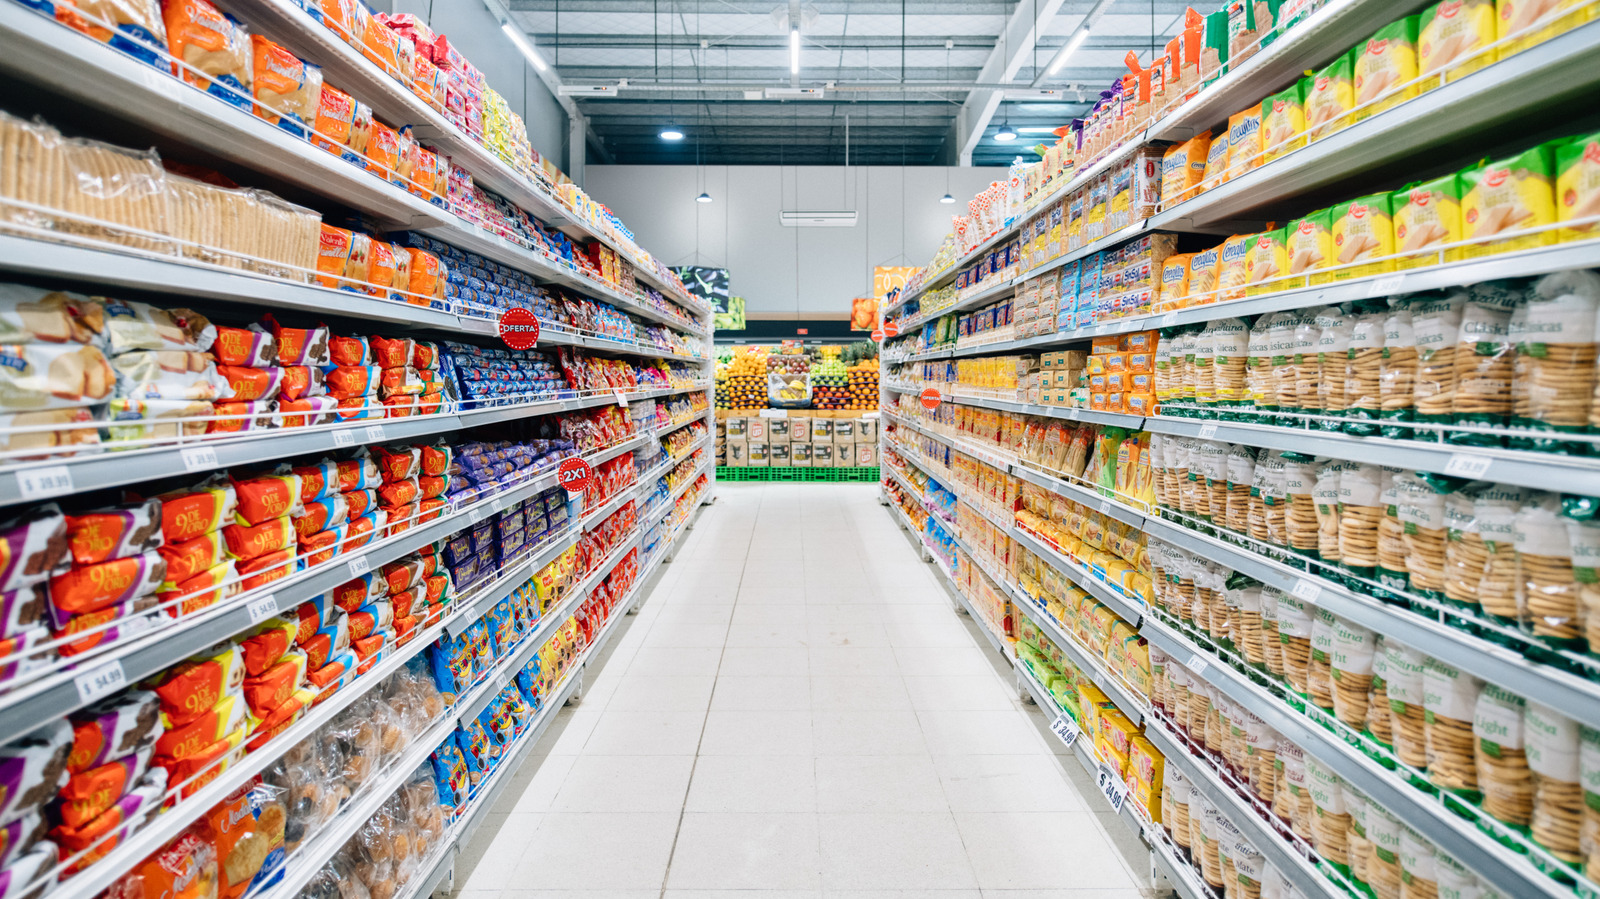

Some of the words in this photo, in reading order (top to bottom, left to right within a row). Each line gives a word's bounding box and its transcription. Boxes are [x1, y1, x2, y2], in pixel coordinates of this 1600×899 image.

[1122, 268, 1140, 282] SinSal
[1121, 294, 1139, 307] SinSal
[503, 324, 536, 332] OFERTA
[347, 374, 354, 391] 9
[354, 382, 365, 390] ORO
[563, 467, 586, 482] 2X1
[261, 495, 271, 515] 9
[270, 492, 280, 501] DE
[270, 501, 287, 513] ORO
[175, 514, 188, 535] 9
[187, 510, 200, 521] DE
[187, 519, 209, 534] ORO
[254, 533, 264, 553] 9
[263, 531, 274, 541] DE
[264, 539, 280, 551] ORO
[90, 566, 105, 594] 9
[105, 565, 118, 576] DE
[104, 574, 132, 591] ORO
[251, 609, 257, 618] $
[258, 601, 276, 614] 54.99
[84, 684, 91, 695] $
[95, 669, 121, 689] 54.99
[185, 694, 198, 714] 9
[199, 686, 210, 697] DE
[199, 692, 217, 711] ORO
[1053, 720, 1061, 730] $
[1058, 725, 1076, 744] 34.99
[1474, 715, 1508, 737] Light
[1100, 773, 1107, 787] $
[1105, 782, 1121, 809] 34.99
[1309, 783, 1329, 804] Light
[1371, 825, 1400, 846] Light
[1236, 860, 1255, 875] Mate
